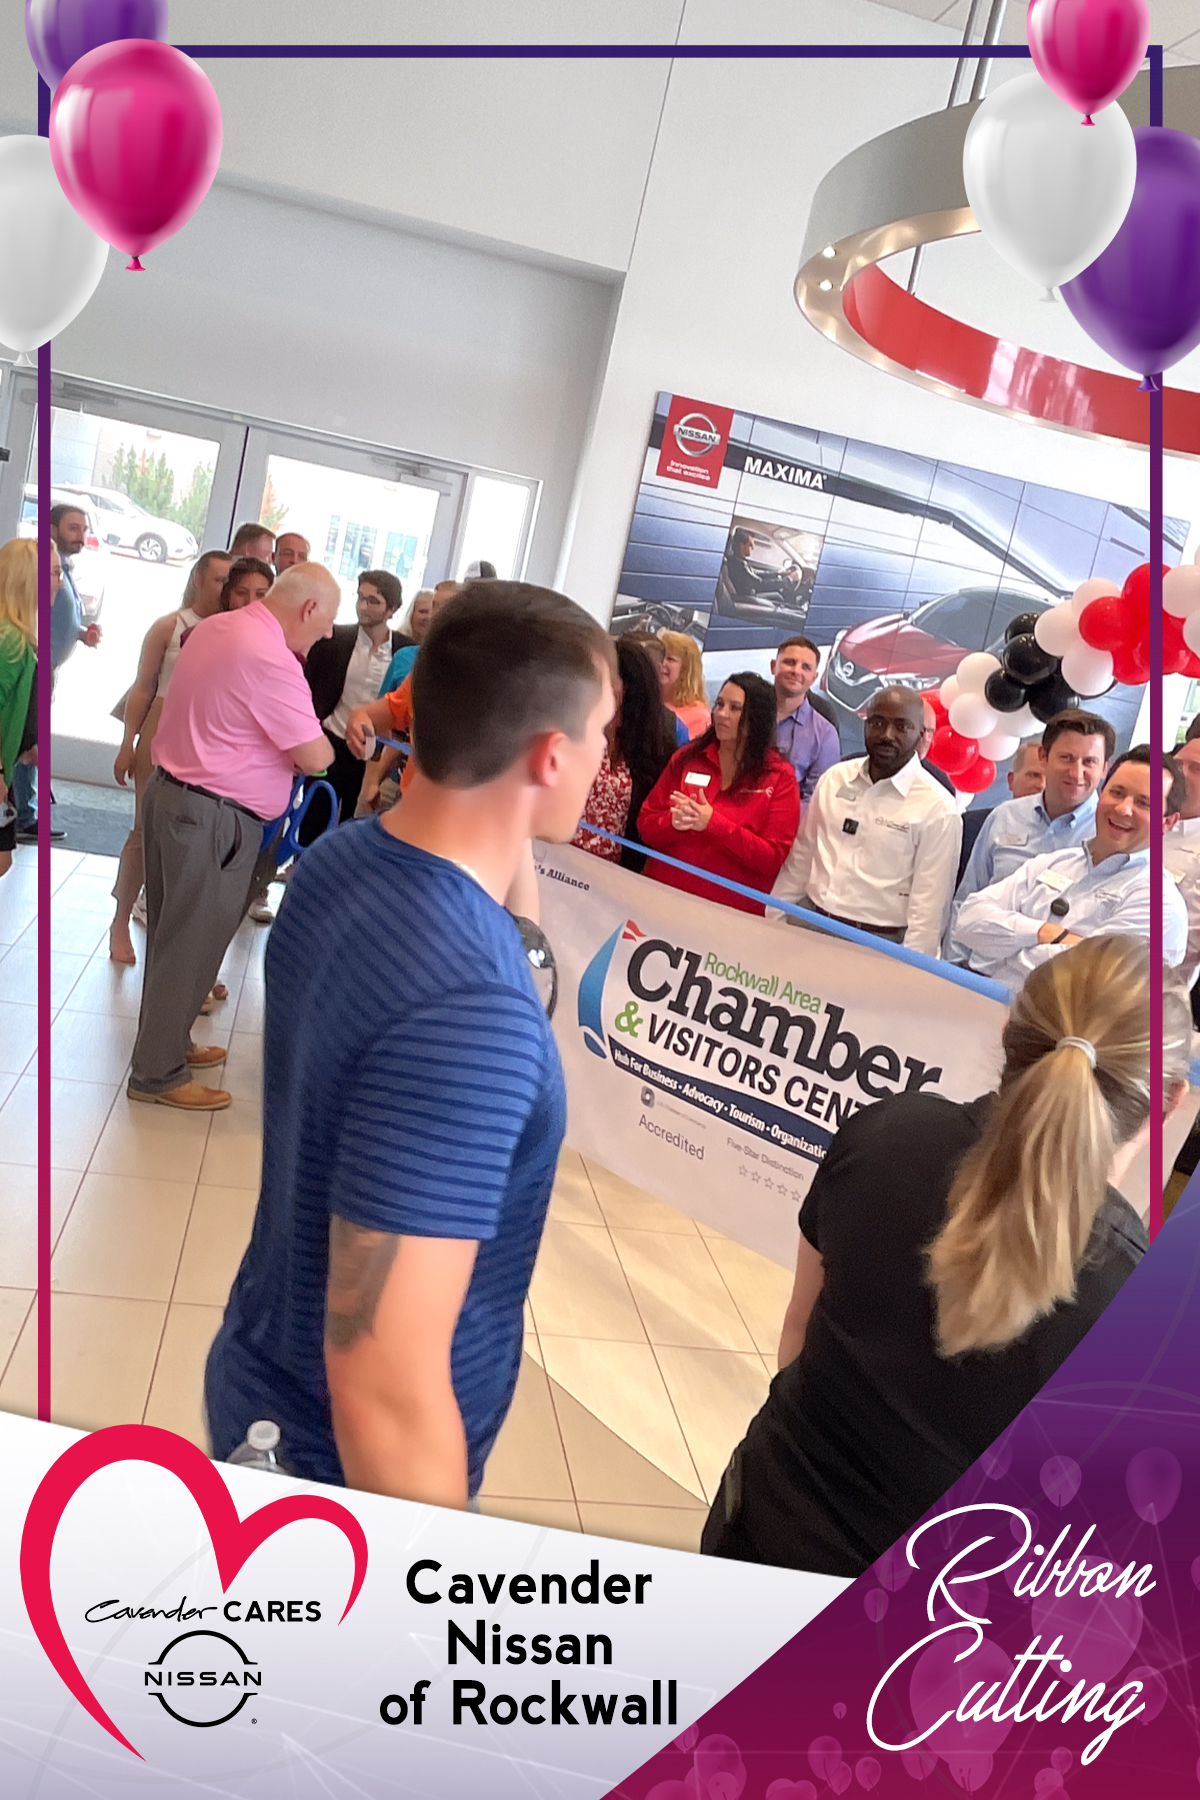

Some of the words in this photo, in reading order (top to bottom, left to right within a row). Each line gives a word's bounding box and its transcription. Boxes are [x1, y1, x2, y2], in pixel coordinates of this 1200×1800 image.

[677, 427, 717, 443] NISSAN
[546, 868, 590, 891] Alliance
[703, 951, 780, 998] Rockwall
[778, 980, 822, 1015] Area
[627, 938, 943, 1099] Chamber
[614, 1000, 644, 1038] &
[648, 1013, 782, 1096] VISITORS
[613, 1048, 631, 1067] Hub
[629, 1056, 643, 1074] For
[642, 1063, 679, 1091] Business
[681, 1082, 725, 1114] Advocacy
[728, 1103, 766, 1132] Tourism
[638, 1113, 706, 1161] Accredited
[761, 1153, 805, 1181] Distinction
